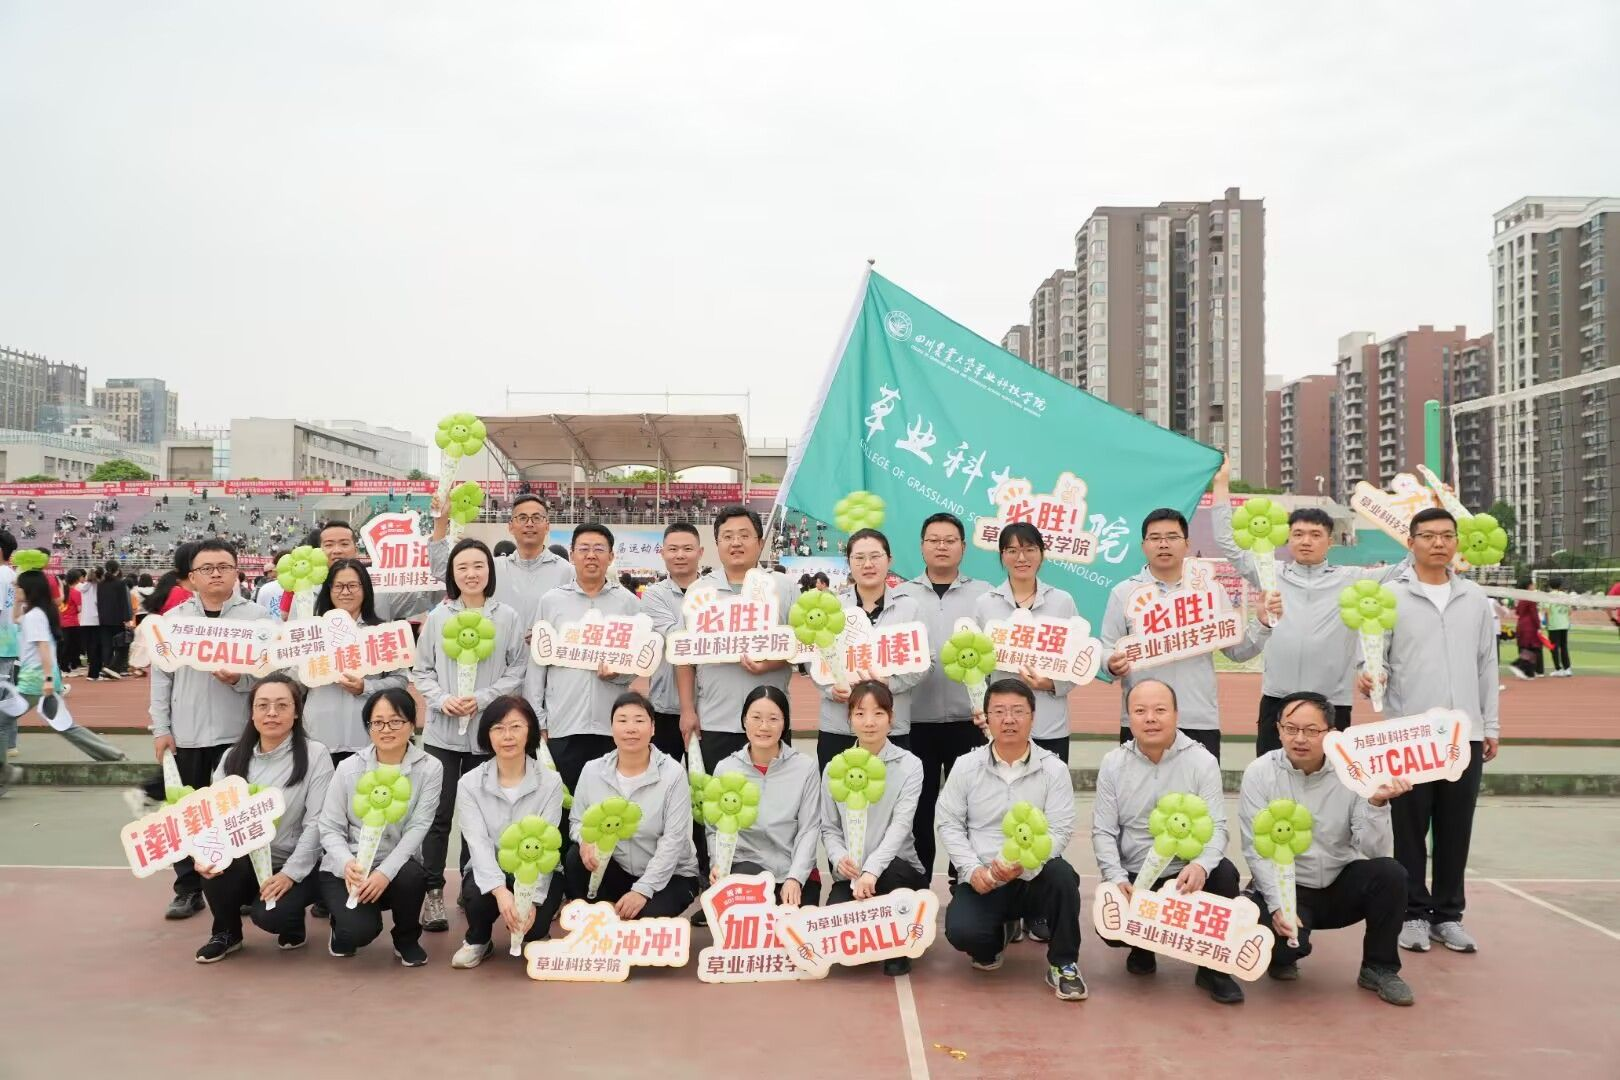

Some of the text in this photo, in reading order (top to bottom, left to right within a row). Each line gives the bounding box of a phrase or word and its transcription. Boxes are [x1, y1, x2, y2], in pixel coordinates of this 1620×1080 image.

[864, 383, 1130, 563] 草业科院
[892, 466, 905, 480] OF
[907, 477, 964, 515] GRASSLAND
[1047, 559, 1112, 587] CHNOLOGY
[1360, 496, 1409, 535] 草业科技学
[981, 525, 1091, 557] 草技学院
[696, 602, 771, 634] 必胜!
[1142, 592, 1214, 635] 必胜!
[171, 623, 254, 640] 为草业科技学院
[290, 625, 323, 642] 草业
[564, 621, 635, 650] 强强强
[673, 633, 790, 657] 草业科技学院
[992, 623, 1069, 654] 强强强
[1125, 618, 1237, 663] 草业科技学院
[179, 640, 259, 666] 打CALL
[276, 641, 326, 659] 科技学院
[308, 628, 411, 678] 棒棒棒!
[555, 646, 635, 667] 草业科技学院
[996, 650, 1068, 674] 业科技学院
[1354, 724, 1431, 750] 为草业科技学院
[1369, 742, 1446, 777] 打CALL
[229, 819, 266, 848] 草业
[806, 905, 893, 932] 为草业科技学院
[1137, 898, 1232, 941] 强强强
[592, 927, 681, 957] 冲冲冲!
[821, 921, 906, 956] 打CALL
[1125, 919, 1232, 964] 草业科技学院
[537, 957, 621, 972] 草业科技学院
[707, 954, 797, 974] 草业科技学
